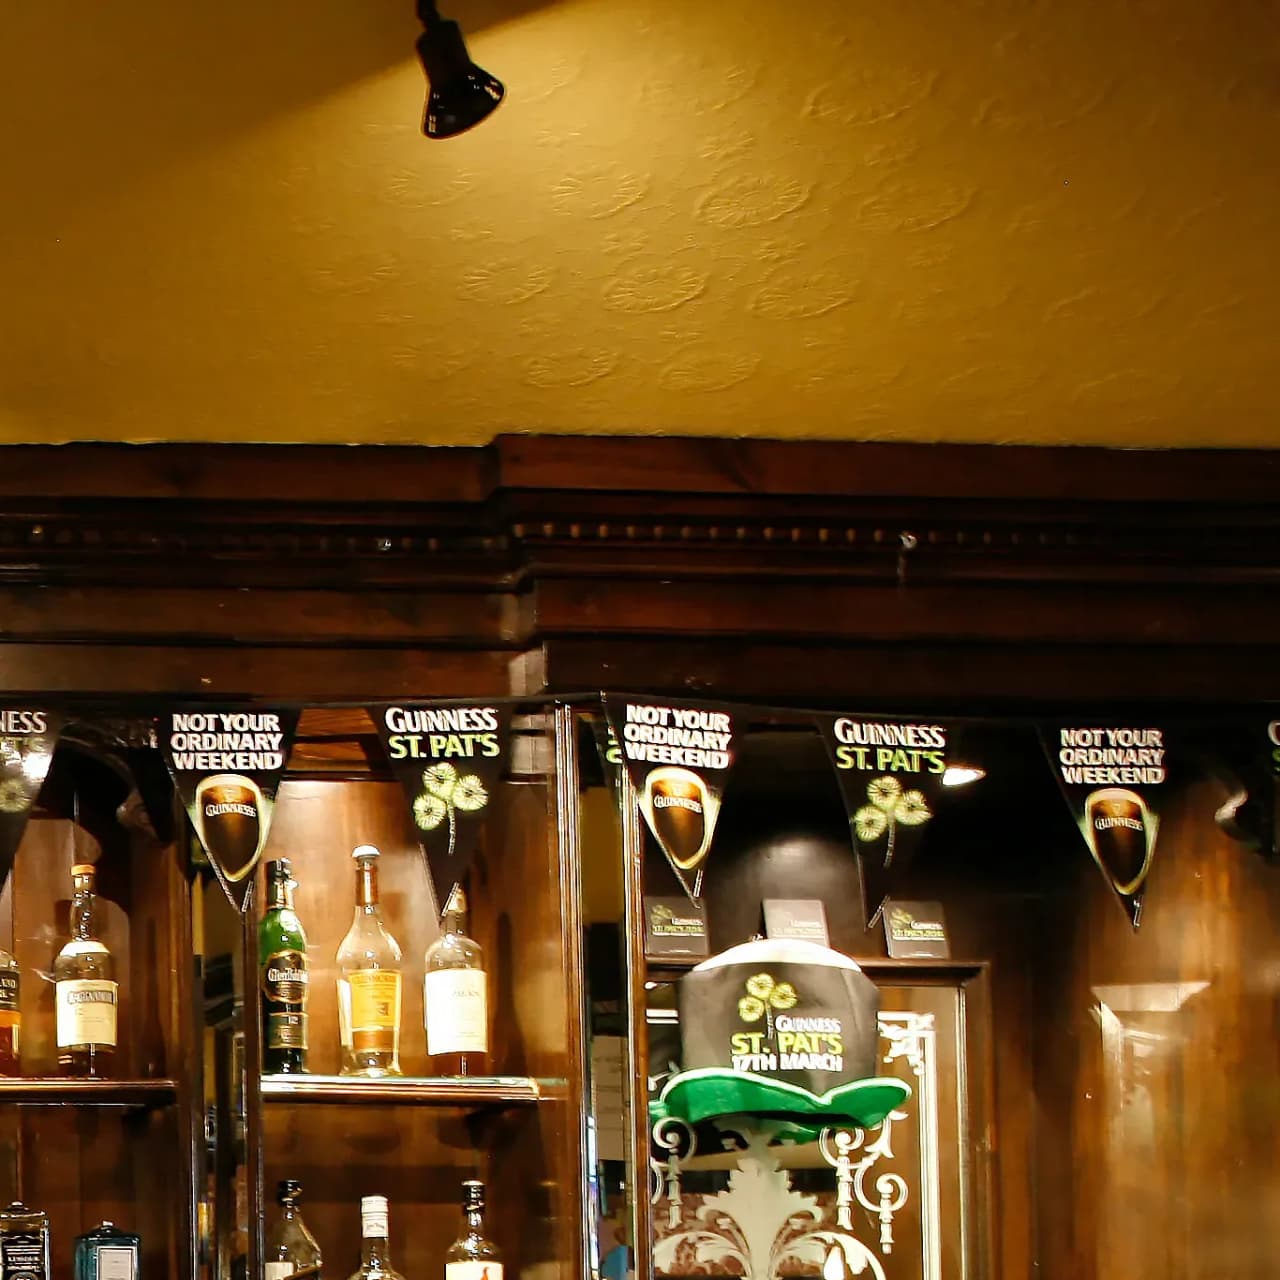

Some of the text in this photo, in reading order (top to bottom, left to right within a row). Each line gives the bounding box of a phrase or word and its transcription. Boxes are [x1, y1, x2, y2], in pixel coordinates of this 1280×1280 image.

[172, 713, 281, 732] NOT YOUR
[385, 706, 498, 733] GUINNESS
[626, 704, 731, 732] NOT YOUR
[170, 733, 284, 751] ORDINARY
[623, 723, 732, 751] ORDINARY
[834, 717, 946, 748] GUINNESS
[1060, 728, 1164, 747] NOT YOUR
[388, 733, 500, 759] ST. PAT'S
[624, 741, 730, 769] WEEKEND
[1059, 747, 1165, 766] ORDINARY
[171, 752, 283, 770] WEEKEND
[836, 745, 946, 774] ST. PAT'S
[1061, 766, 1166, 784] WEEKEND
[775, 1014, 842, 1034] GUINNESS
[731, 1032, 844, 1055] ST. PAT'S
[732, 1053, 843, 1072] 17TH MARCH
